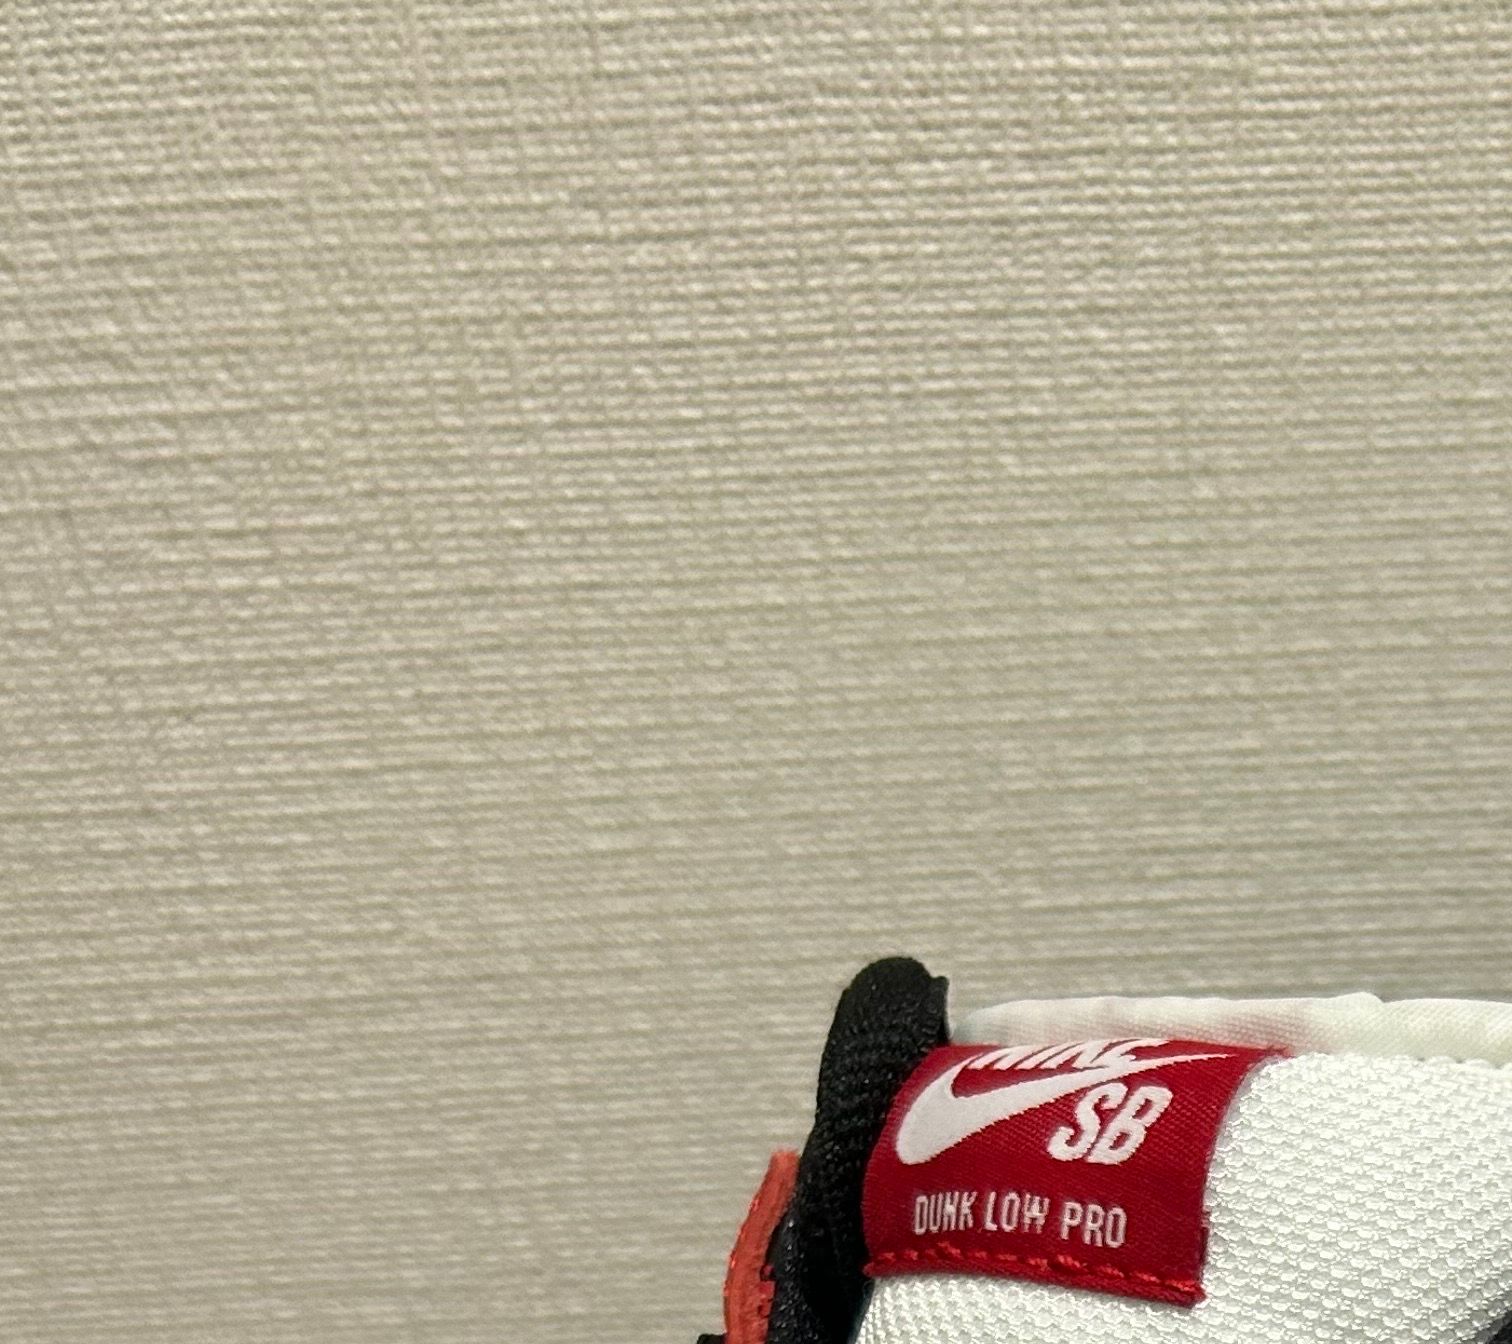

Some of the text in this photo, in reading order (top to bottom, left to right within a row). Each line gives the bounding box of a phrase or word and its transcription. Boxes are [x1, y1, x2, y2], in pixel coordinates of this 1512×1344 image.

[1047, 1081, 1174, 1165] SB
[914, 1190, 1127, 1249] DUNK LOW PRO
